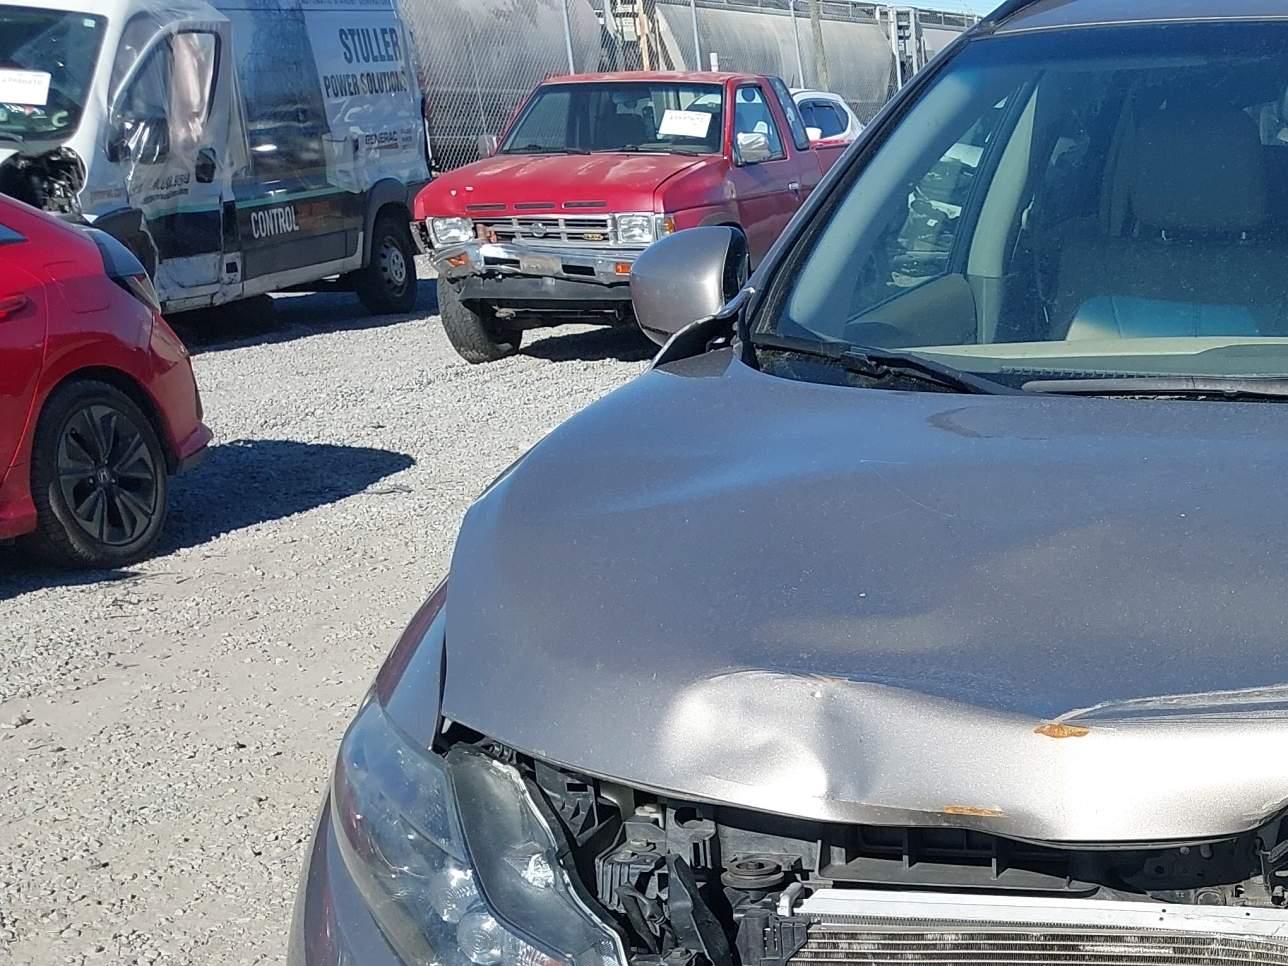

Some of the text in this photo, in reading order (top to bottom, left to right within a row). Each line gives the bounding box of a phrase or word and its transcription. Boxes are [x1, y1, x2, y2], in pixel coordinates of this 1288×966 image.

[339, 27, 402, 64] STULLER
[323, 71, 407, 98] POWER SOLUTIONS
[251, 206, 299, 239] CONTROL
